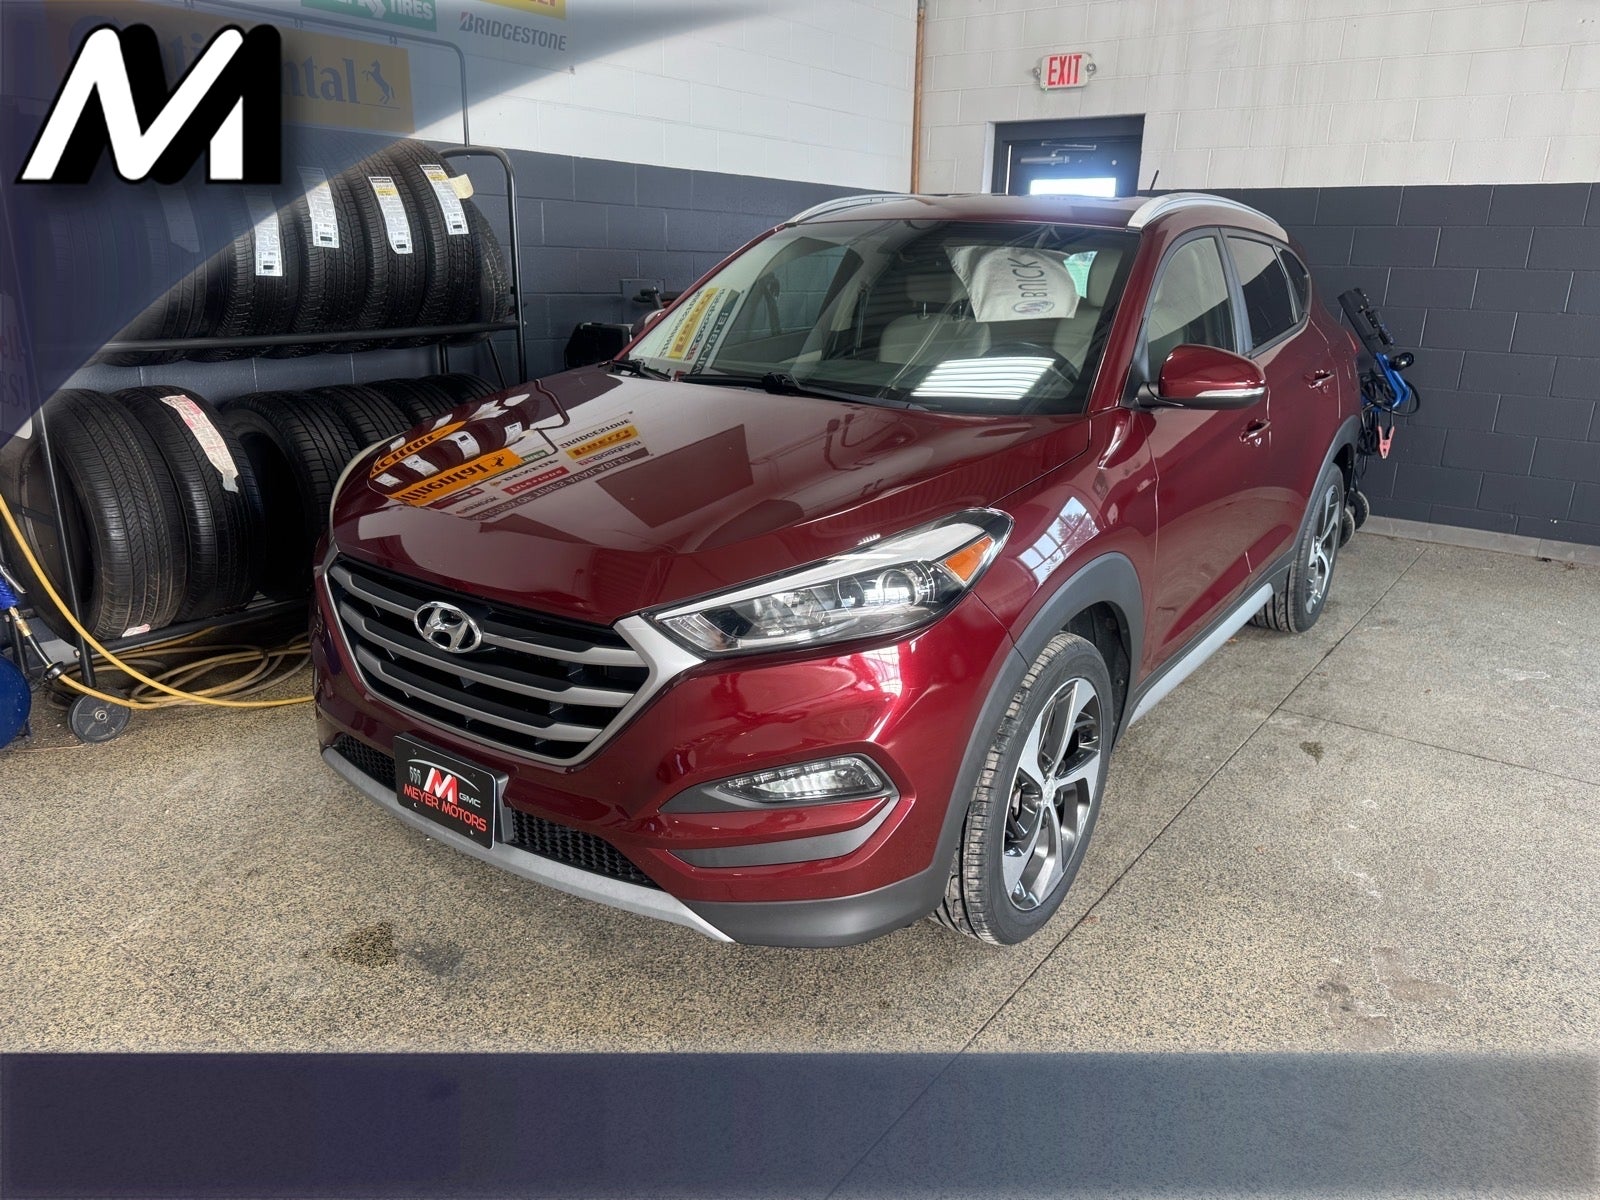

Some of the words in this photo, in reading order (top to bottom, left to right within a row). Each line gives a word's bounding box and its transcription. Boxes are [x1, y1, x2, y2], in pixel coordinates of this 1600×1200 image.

[459, 12, 567, 51] BRIDGESTONE
[1047, 54, 1083, 86] EXIT
[403, 784, 440, 810] MEYER
[441, 802, 488, 832] MOTORS
[459, 792, 481, 808] GMC
